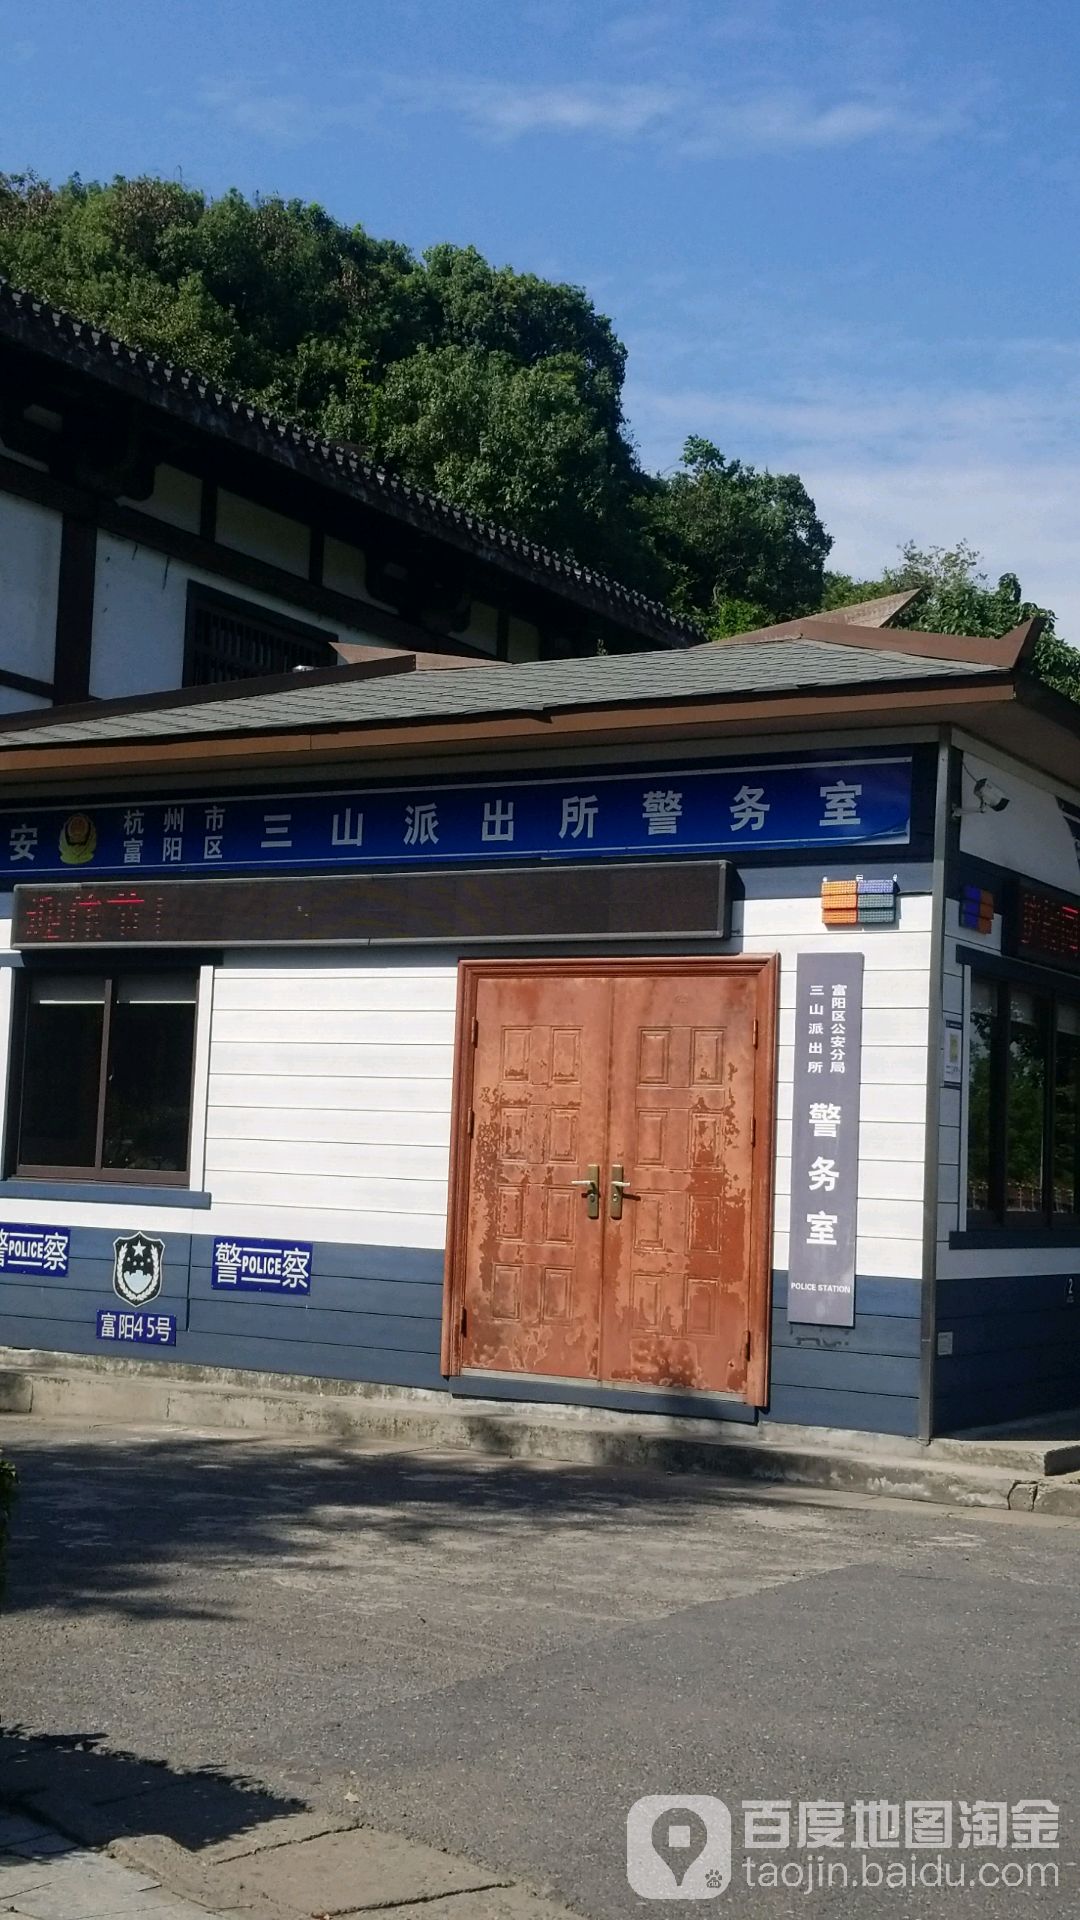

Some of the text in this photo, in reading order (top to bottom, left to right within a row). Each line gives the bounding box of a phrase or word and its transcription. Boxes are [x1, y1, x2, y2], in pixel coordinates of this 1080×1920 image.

[122, 805, 227, 835] 杭州市
[261, 780, 863, 849] 三山派出所警务室
[9, 824, 39, 862] 安
[122, 835, 225, 864] 富阳区
[807, 985, 825, 1074] 三山派出所
[830, 984, 847, 1074] 富阳区公安分局
[806, 1103, 842, 1246] 警务室
[790, 1282, 851, 1294] POLICE STATION
[101, 1312, 172, 1342] 富阳45号
